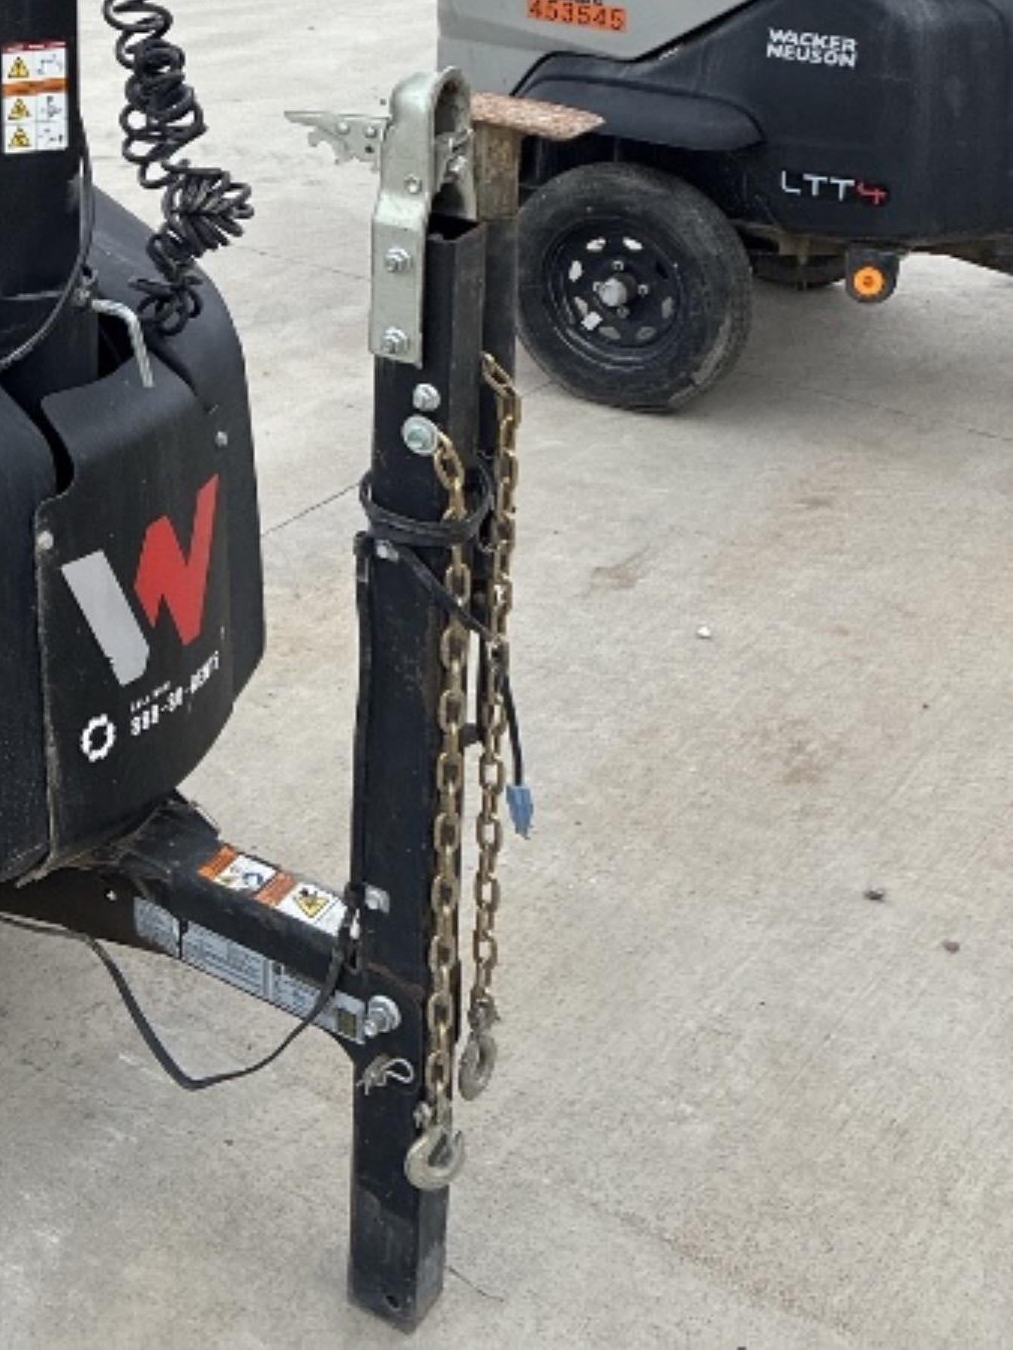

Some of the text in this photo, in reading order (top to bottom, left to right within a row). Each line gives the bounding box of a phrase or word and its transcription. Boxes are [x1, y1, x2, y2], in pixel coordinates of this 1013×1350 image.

[767, 27, 857, 53] WACKER
[766, 43, 857, 68] NEUSON
[781, 169, 888, 205] LTT4
